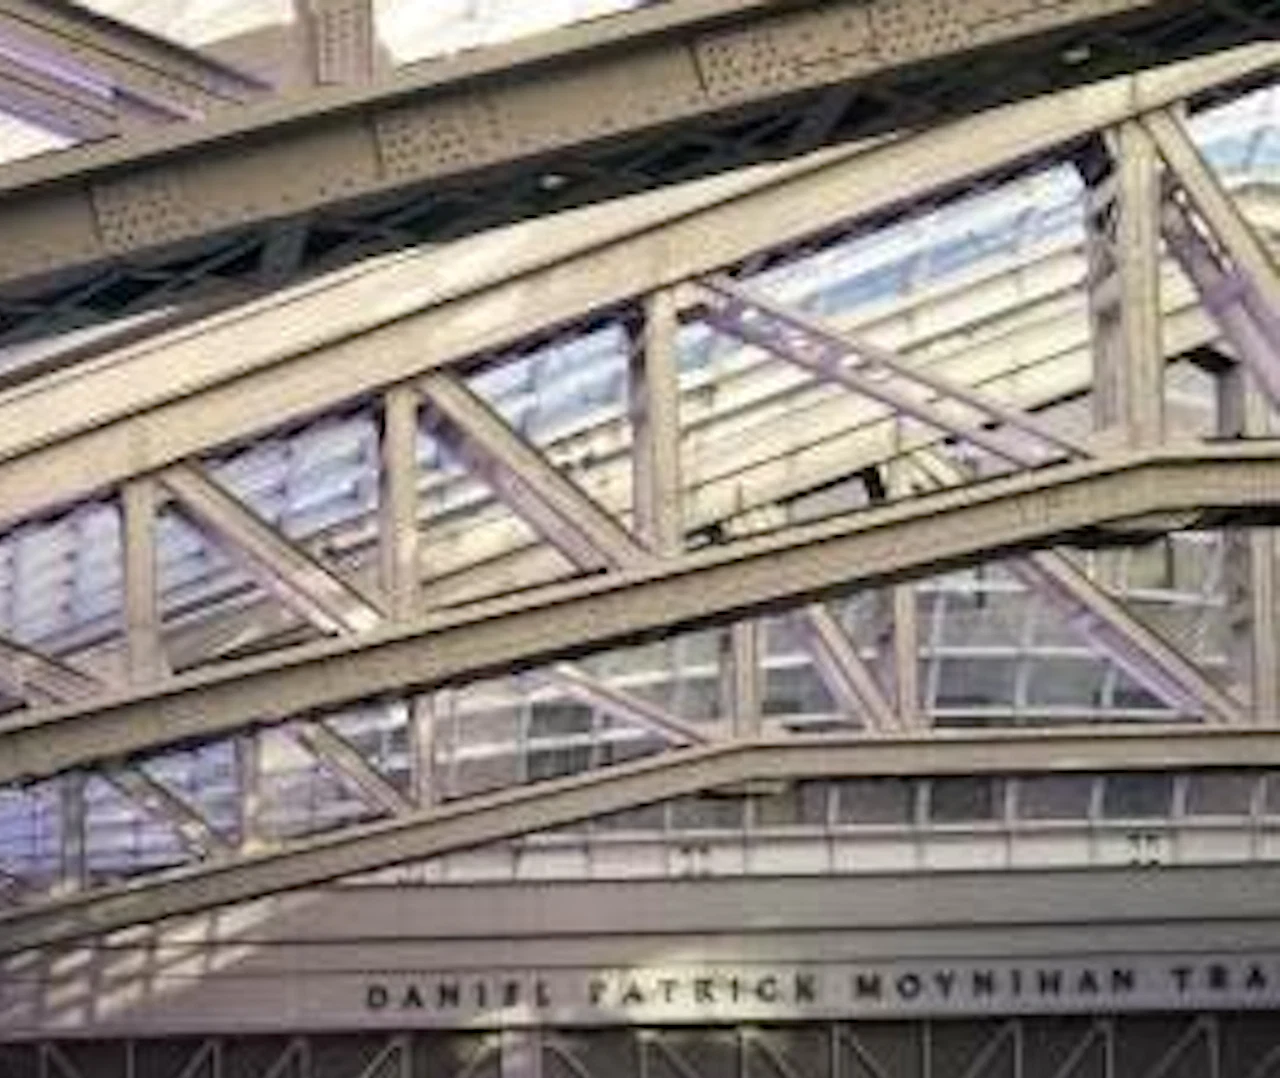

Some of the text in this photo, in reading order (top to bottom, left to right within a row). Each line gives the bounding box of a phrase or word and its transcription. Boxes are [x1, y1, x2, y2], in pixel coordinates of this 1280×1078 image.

[366, 978, 551, 1010] DANIEL
[588, 974, 818, 1005] PATRICK
[856, 967, 1137, 1000] MOYNIHAN
